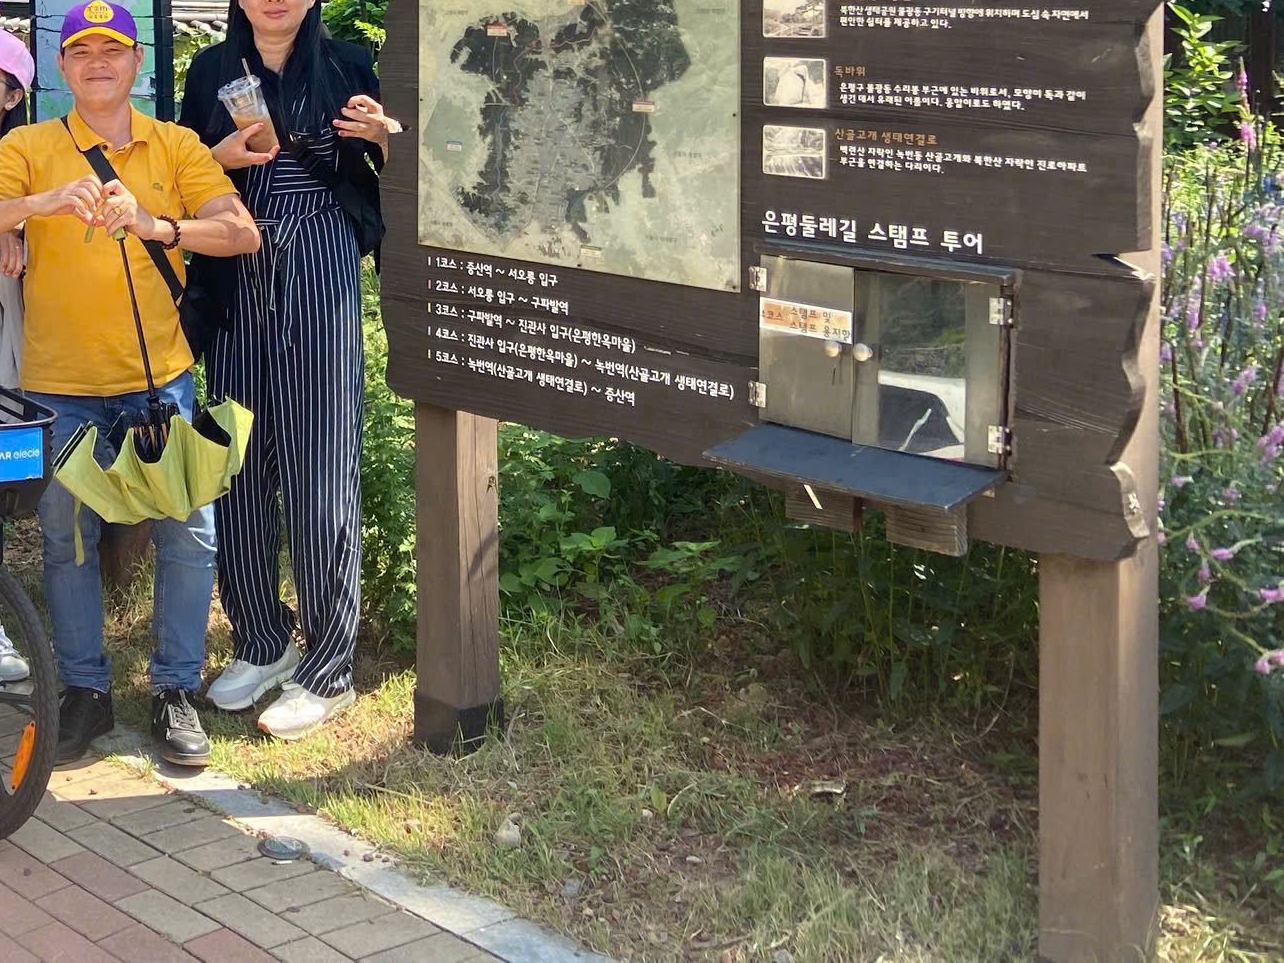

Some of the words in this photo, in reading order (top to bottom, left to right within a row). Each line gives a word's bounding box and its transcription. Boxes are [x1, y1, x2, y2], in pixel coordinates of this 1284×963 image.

[839, 5, 863, 15] 북한산
[834, 65, 867, 77] 독바위
[839, 82, 865, 94] 은평구
[834, 128, 877, 142] 산골고개
[881, 131, 938, 147] 생태연결로
[761, 210, 857, 243] 은평둘레길
[867, 222, 930, 249] 스탬프
[940, 230, 984, 255] 투어
[435, 257, 458, 269] 1코스
[466, 261, 493, 278] 증산역
[508, 268, 536, 286] 서오릉
[538, 273, 559, 287] 입구
[435, 280, 459, 293] 2코스
[467, 286, 494, 303] 서오릉
[496, 291, 516, 305] 입구
[530, 296, 569, 316] 구파발역
[435, 304, 459, 317] 3코스
[467, 309, 503, 329] 구파발역
[518, 318, 547, 335] 진관사
[549, 324, 636, 354] 입구(은평한옥마을)
[435, 327, 459, 341] 4코스
[467, 333, 494, 350] 진관사
[496, 340, 578, 368] 입구(은평한옥마을)
[674, 374, 735, 401] 생태연결로)
[435, 350, 459, 364] 5코스
[535, 370, 588, 396] 생태연결로)
[604, 386, 635, 407] 증산역
[13, 448, 40, 460] elecle
